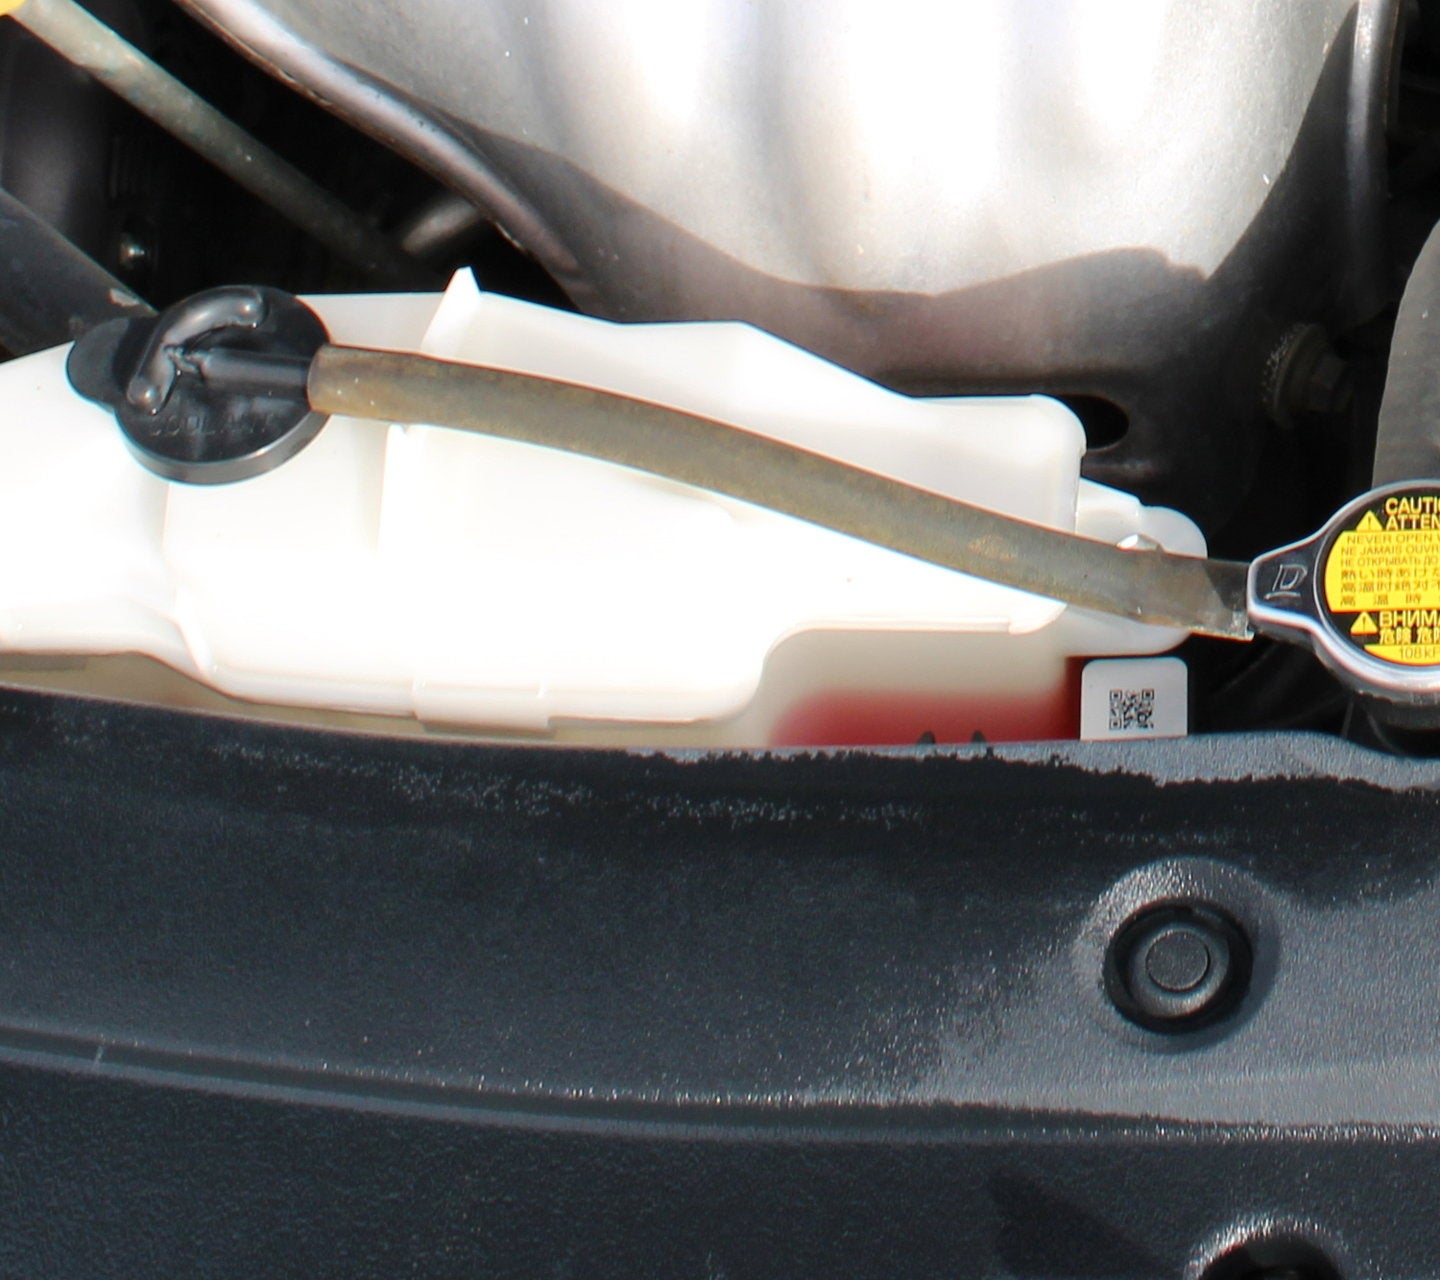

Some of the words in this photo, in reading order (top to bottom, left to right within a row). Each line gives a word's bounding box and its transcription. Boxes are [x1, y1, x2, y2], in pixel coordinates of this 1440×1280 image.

[1346, 533, 1394, 545] NEVER
[1397, 532, 1434, 544] OPEN
[1340, 545, 1357, 557] NE
[1359, 544, 1402, 556] JAMAIS
